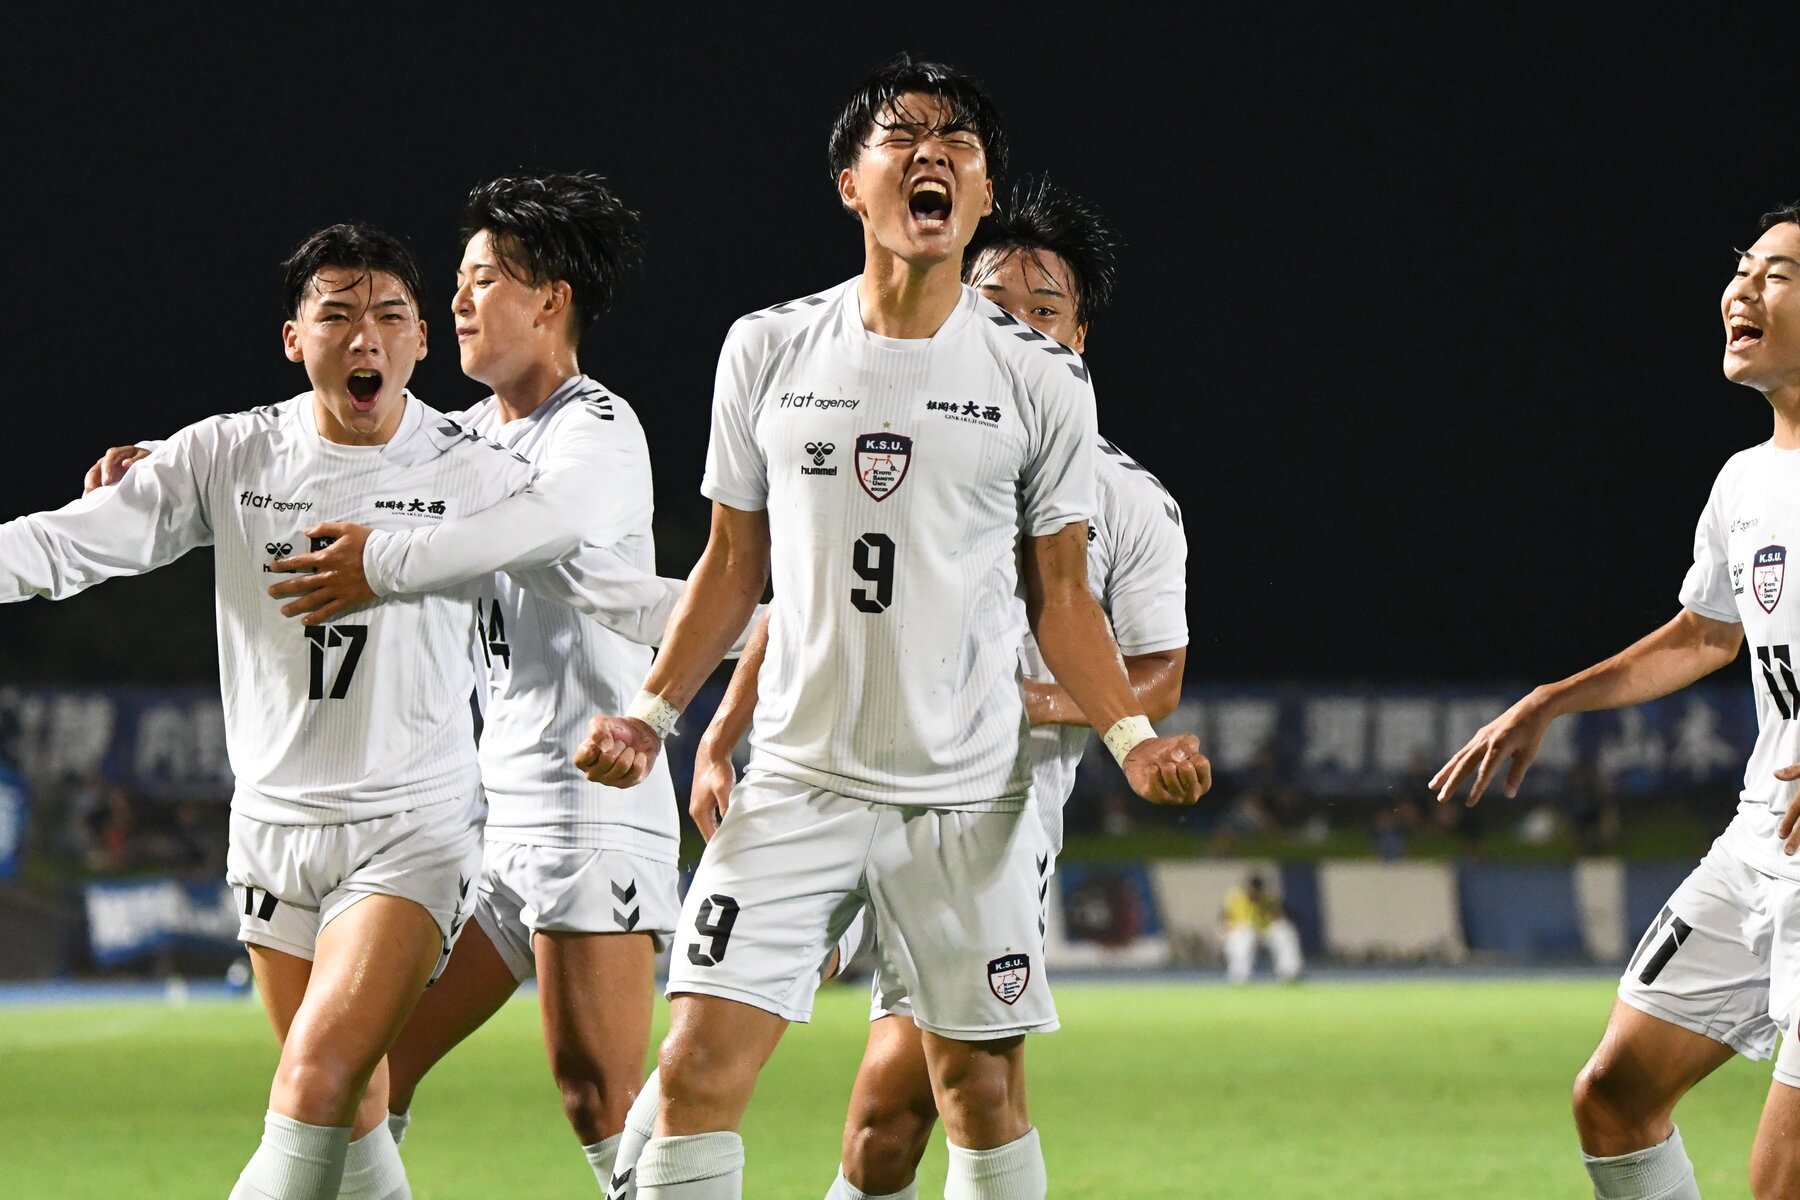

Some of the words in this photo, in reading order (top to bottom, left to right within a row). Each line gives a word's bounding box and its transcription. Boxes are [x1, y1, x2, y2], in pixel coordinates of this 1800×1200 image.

[780, 392, 814, 408] flat
[815, 399, 860, 410] agency
[866, 440, 903, 451] K.S.U.
[801, 465, 837, 476] hummel
[240, 491, 273, 509] flat
[273, 501, 313, 512] agency
[1759, 552, 1782, 564] K.S.U.
[851, 532, 896, 614] 9
[477, 597, 511, 670] 14
[304, 625, 368, 700] 17
[1757, 644, 1800, 720] 11
[687, 893, 741, 967] 9
[995, 958, 1024, 971] K.S.U.
